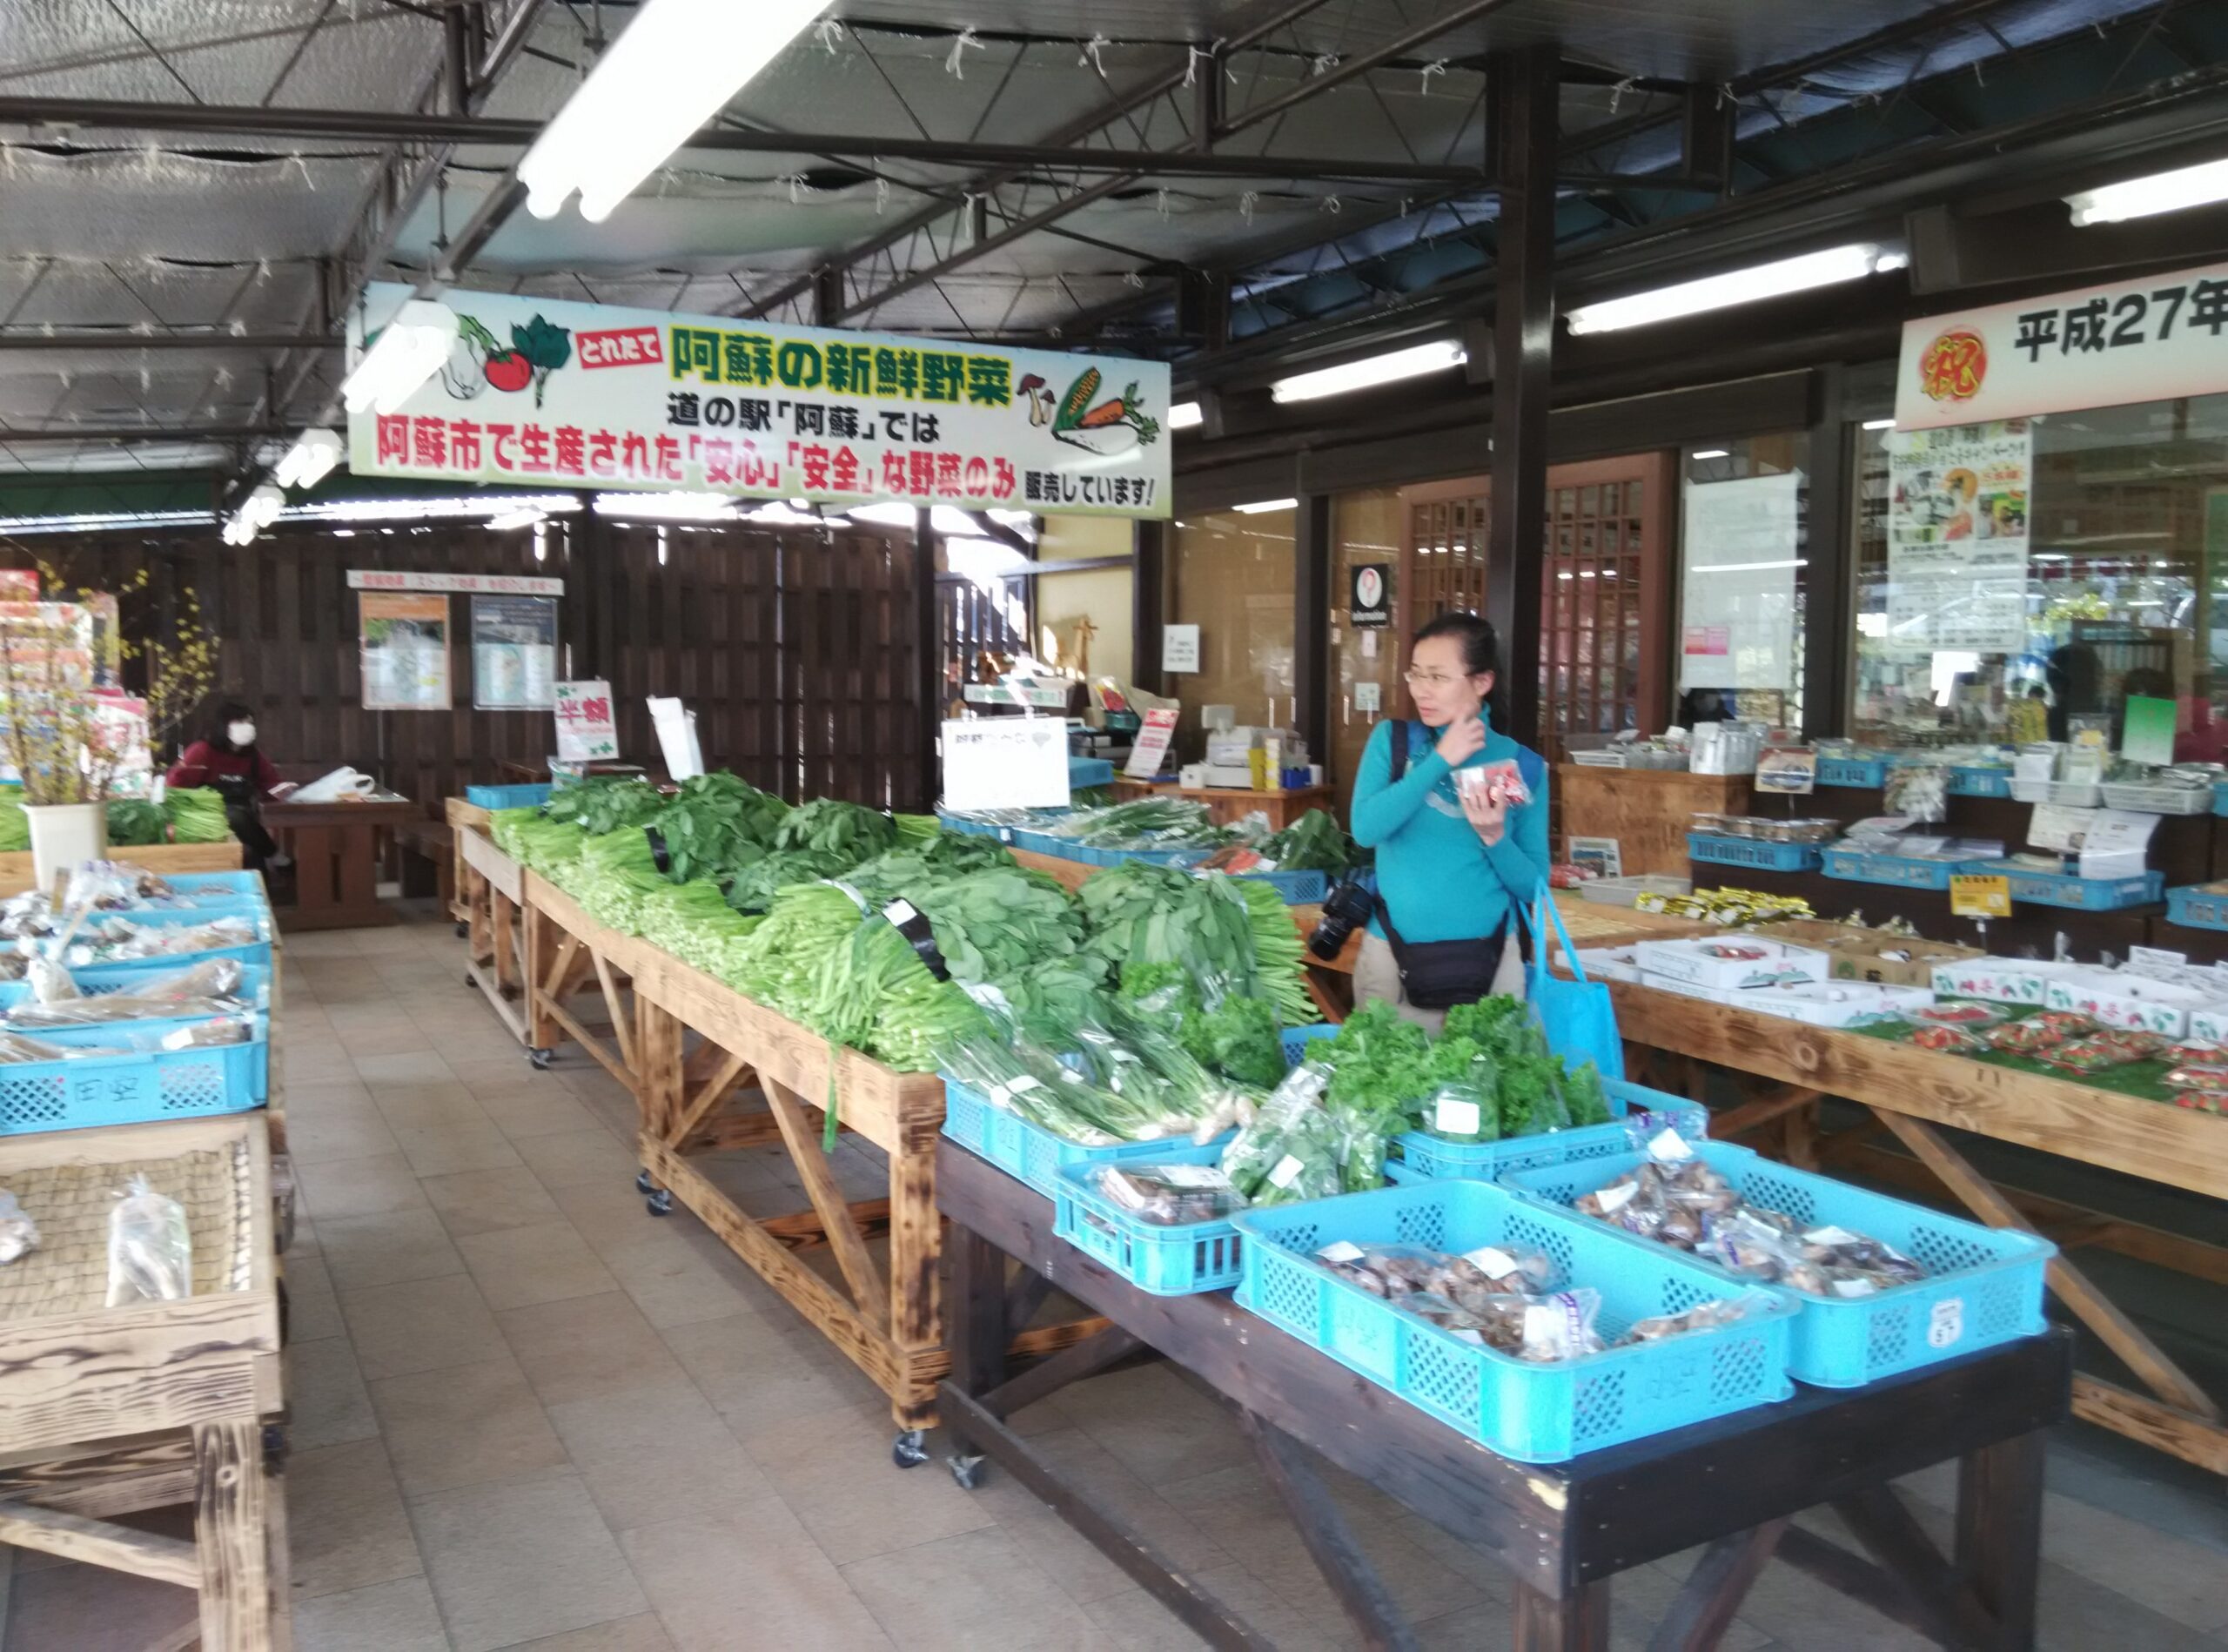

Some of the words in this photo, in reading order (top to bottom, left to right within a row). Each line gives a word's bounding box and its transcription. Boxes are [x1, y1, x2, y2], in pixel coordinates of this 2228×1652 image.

[580, 332, 661, 366] とれたて
[2014, 279, 2228, 363] 平成27年
[669, 324, 1013, 409] 阿蘇の新鮮野菜
[668, 391, 941, 442] 道の駅「阿蘇」では
